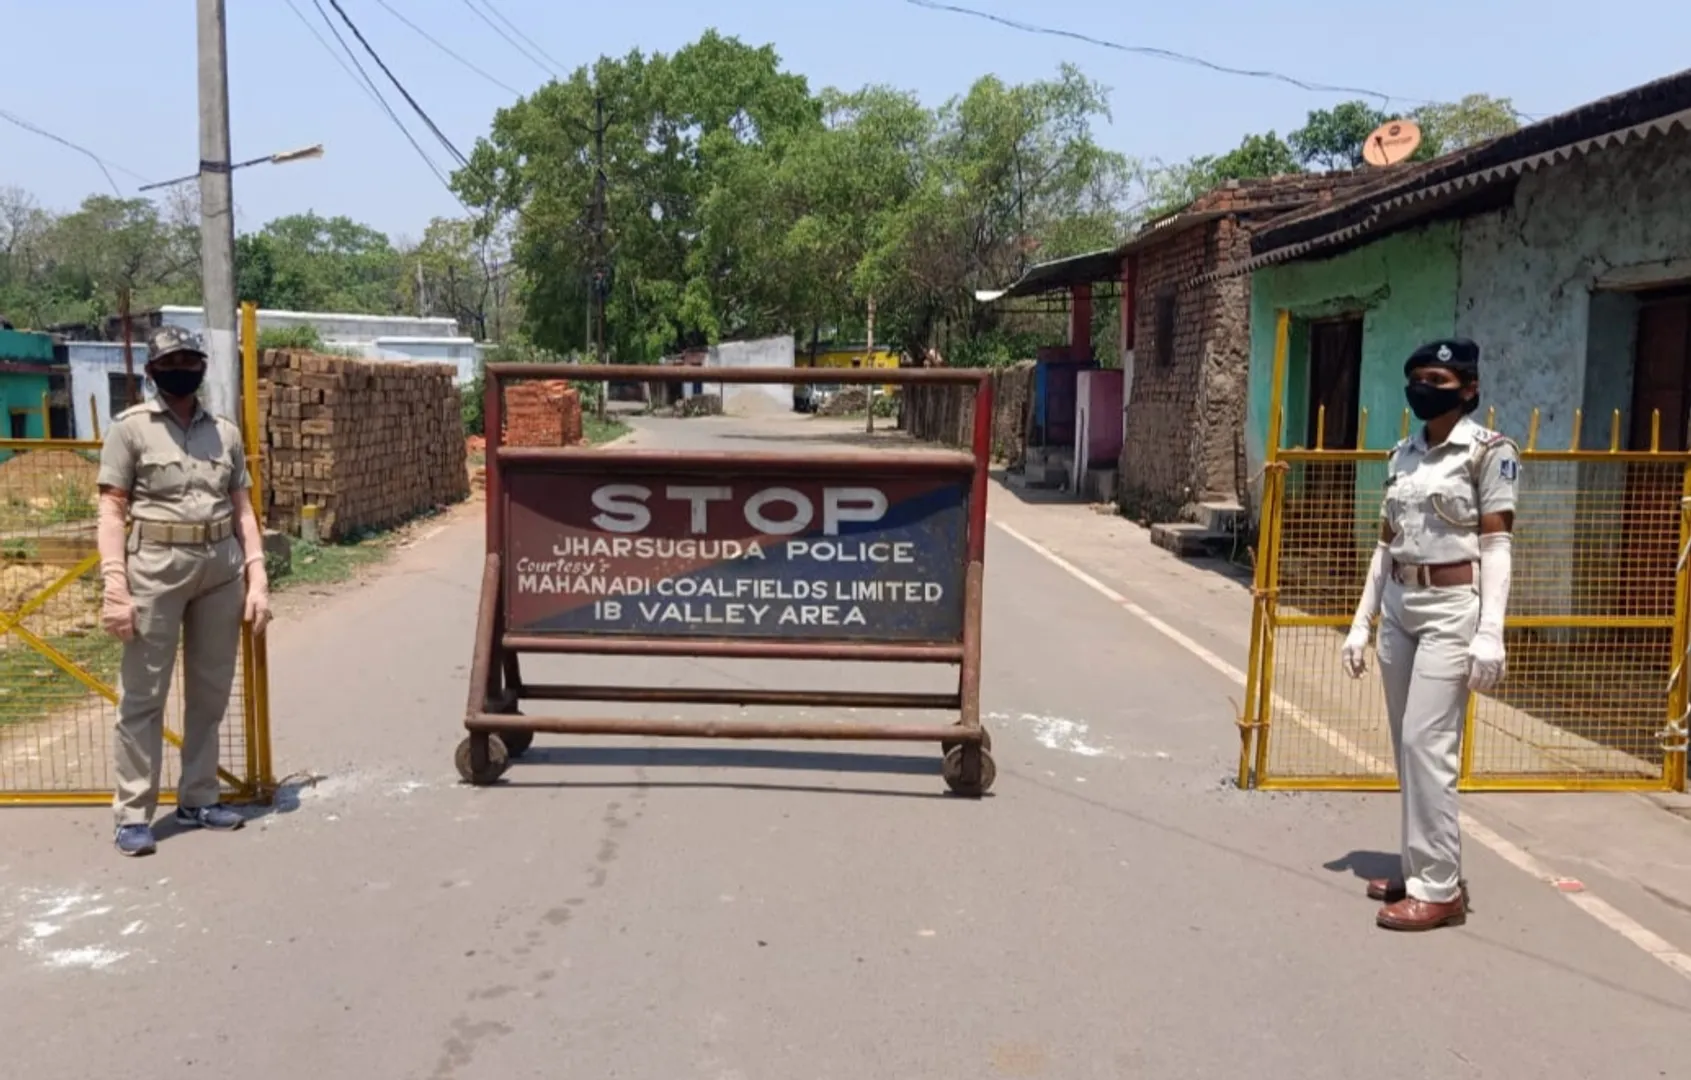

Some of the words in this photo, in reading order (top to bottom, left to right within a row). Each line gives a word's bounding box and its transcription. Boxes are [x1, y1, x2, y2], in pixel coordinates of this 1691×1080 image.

[591, 484, 889, 535] STOP
[552, 536, 765, 562] JHARSUGUDA
[787, 541, 915, 563] POLICE
[517, 574, 650, 596] MAHANADI
[656, 578, 828, 600] COALFIELDS
[835, 581, 944, 603] LIMITED
[594, 602, 621, 621] IB
[639, 603, 771, 625] VALLEY
[778, 605, 867, 626] AREA
